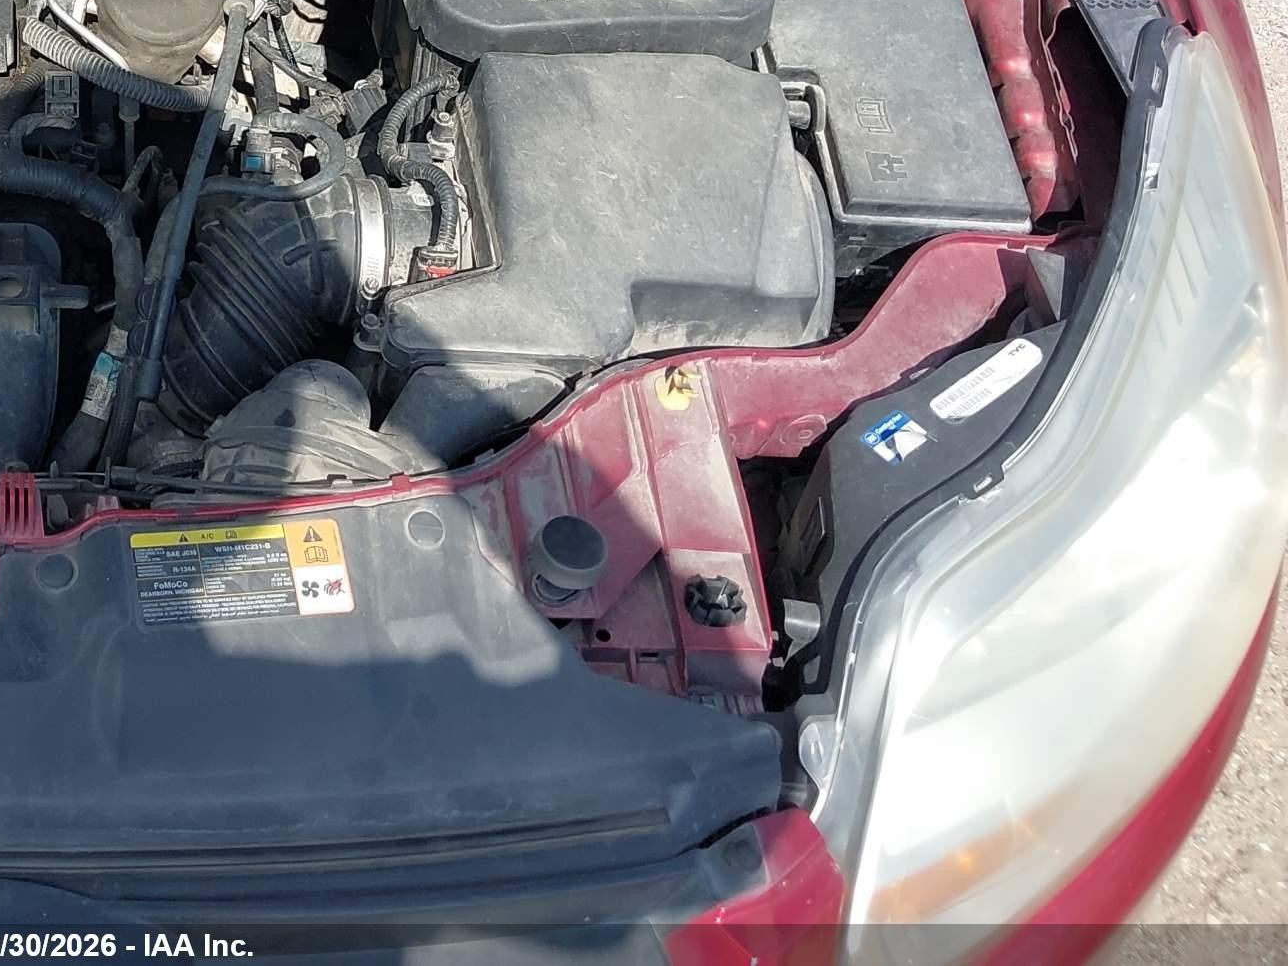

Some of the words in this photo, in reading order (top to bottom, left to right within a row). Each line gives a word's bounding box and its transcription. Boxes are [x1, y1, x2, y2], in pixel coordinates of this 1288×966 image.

[166, 550, 181, 558] SAE
[172, 566, 197, 574] R-134A
[153, 580, 188, 590] FoMoCo
